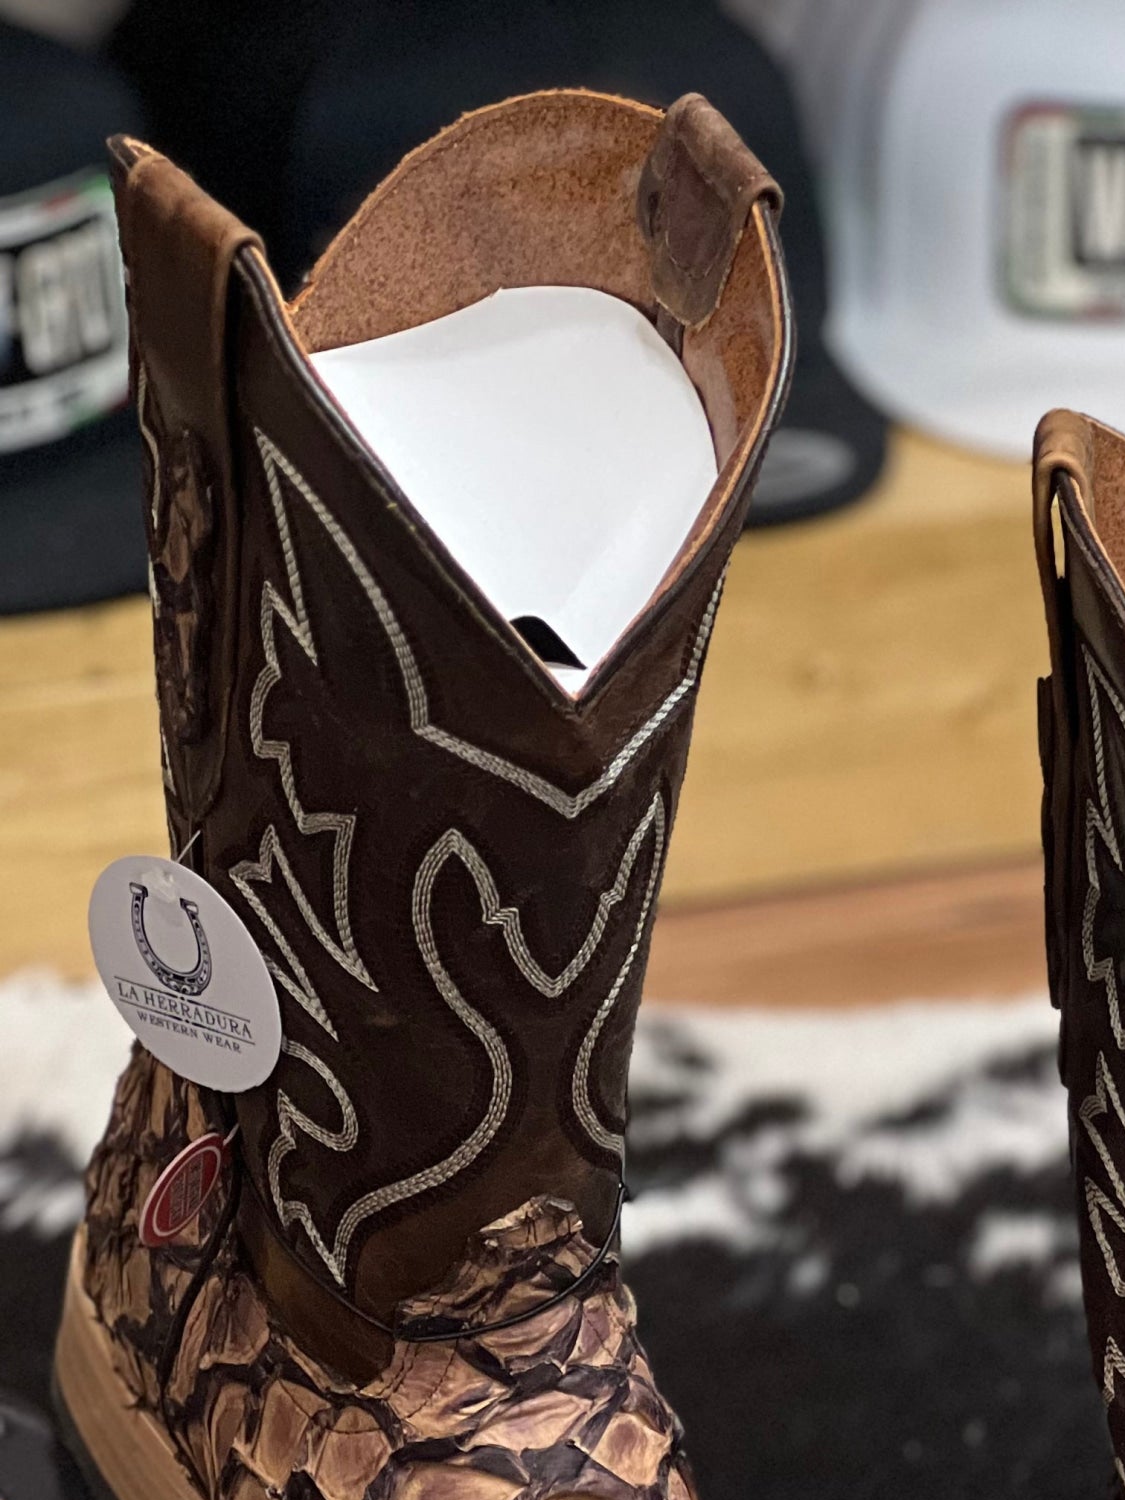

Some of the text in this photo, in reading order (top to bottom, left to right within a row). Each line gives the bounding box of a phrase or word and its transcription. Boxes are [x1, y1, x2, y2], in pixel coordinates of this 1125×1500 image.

[118, 982, 253, 1039] LA HERRADURA
[137, 1011, 242, 1054] WESTERN WEAR
